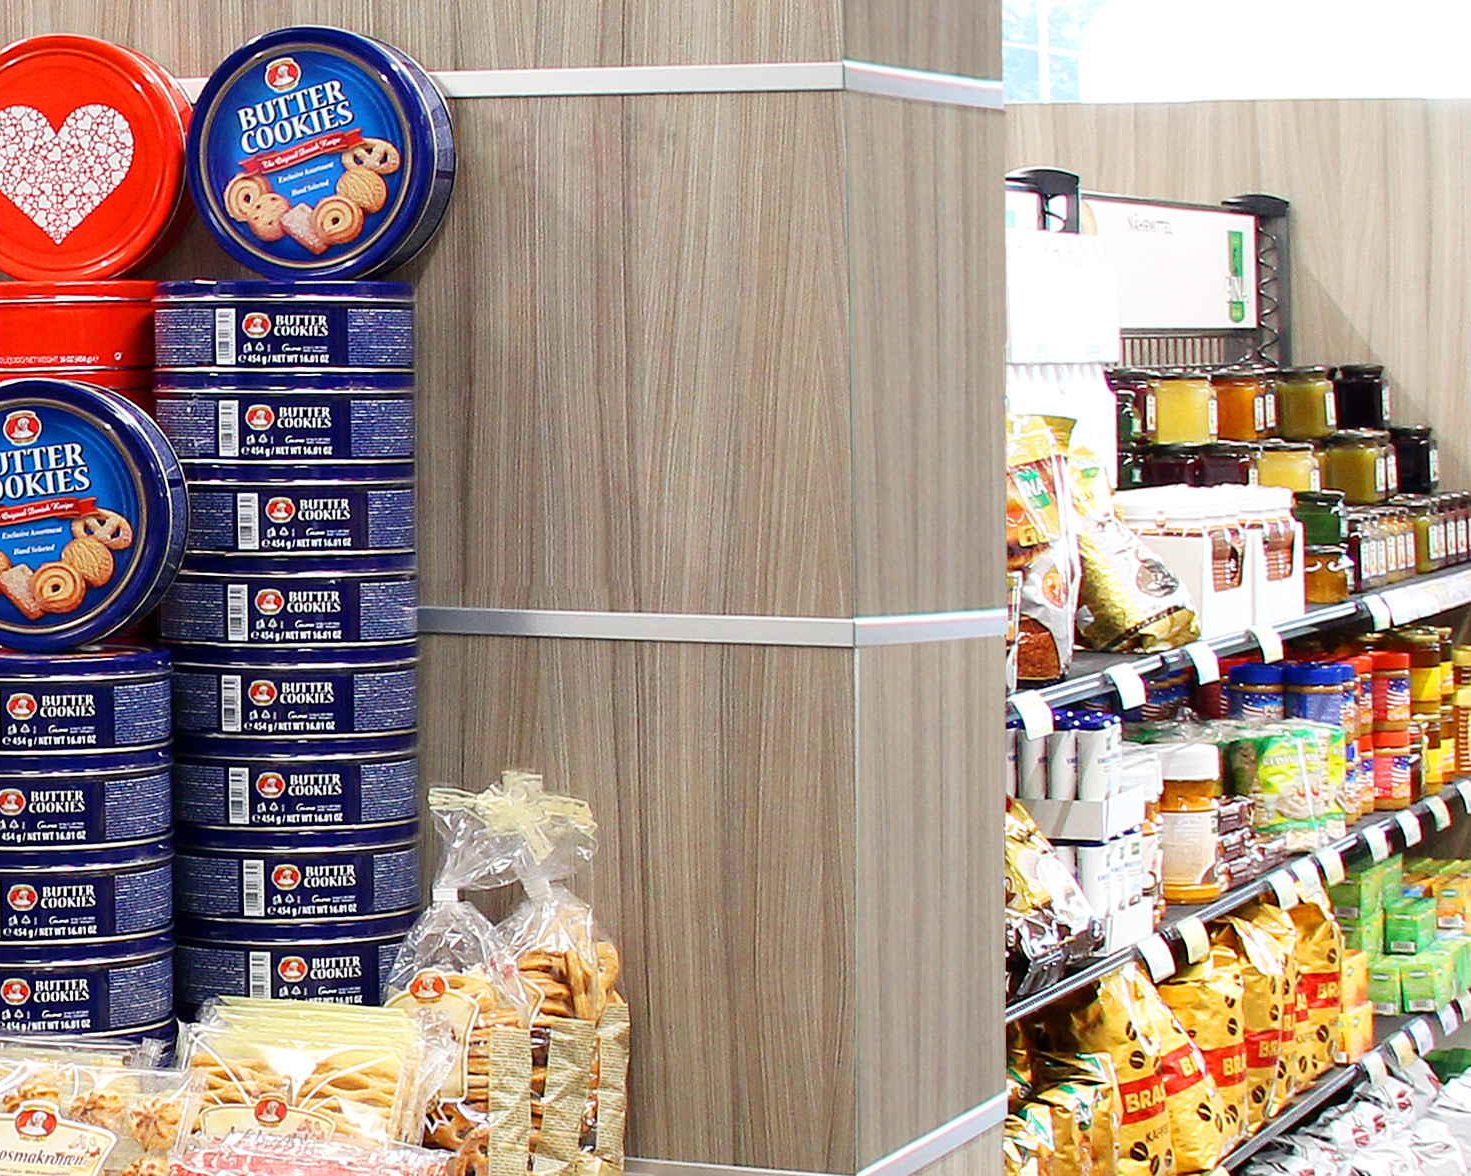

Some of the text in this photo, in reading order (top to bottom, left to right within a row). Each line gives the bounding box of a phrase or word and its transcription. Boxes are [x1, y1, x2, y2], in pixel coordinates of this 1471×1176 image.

[237, 79, 348, 133] BUTTER
[240, 100, 355, 154] COOKIES
[274, 313, 328, 326] BUTTER
[273, 325, 329, 338] COOKIES
[277, 405, 331, 418] BUTTER
[276, 417, 332, 429] COOKIES
[299, 498, 350, 510] BUTTER
[297, 509, 352, 521] COOKIES
[288, 591, 341, 602] BUTTER
[286, 601, 342, 613] COOKIES
[280, 681, 334, 694] BUTTER
[42, 694, 94, 707] BUTTER
[280, 692, 335, 704] COOKIES
[39, 705, 96, 718] COOKIES
[289, 773, 341, 785] BUTTER
[31, 790, 84, 802] BUTTER
[288, 784, 343, 796] COOKIES
[28, 801, 86, 814] COOKIES
[305, 864, 356, 877] BUTTER
[304, 875, 357, 888] COOKIES
[42, 885, 95, 898] BUTTER
[40, 896, 96, 909] COOKIES
[311, 956, 361, 969] BUTTER
[310, 967, 362, 980] COOKIES
[35, 979, 89, 991] BUTTER
[33, 990, 90, 1003] COOKIES
